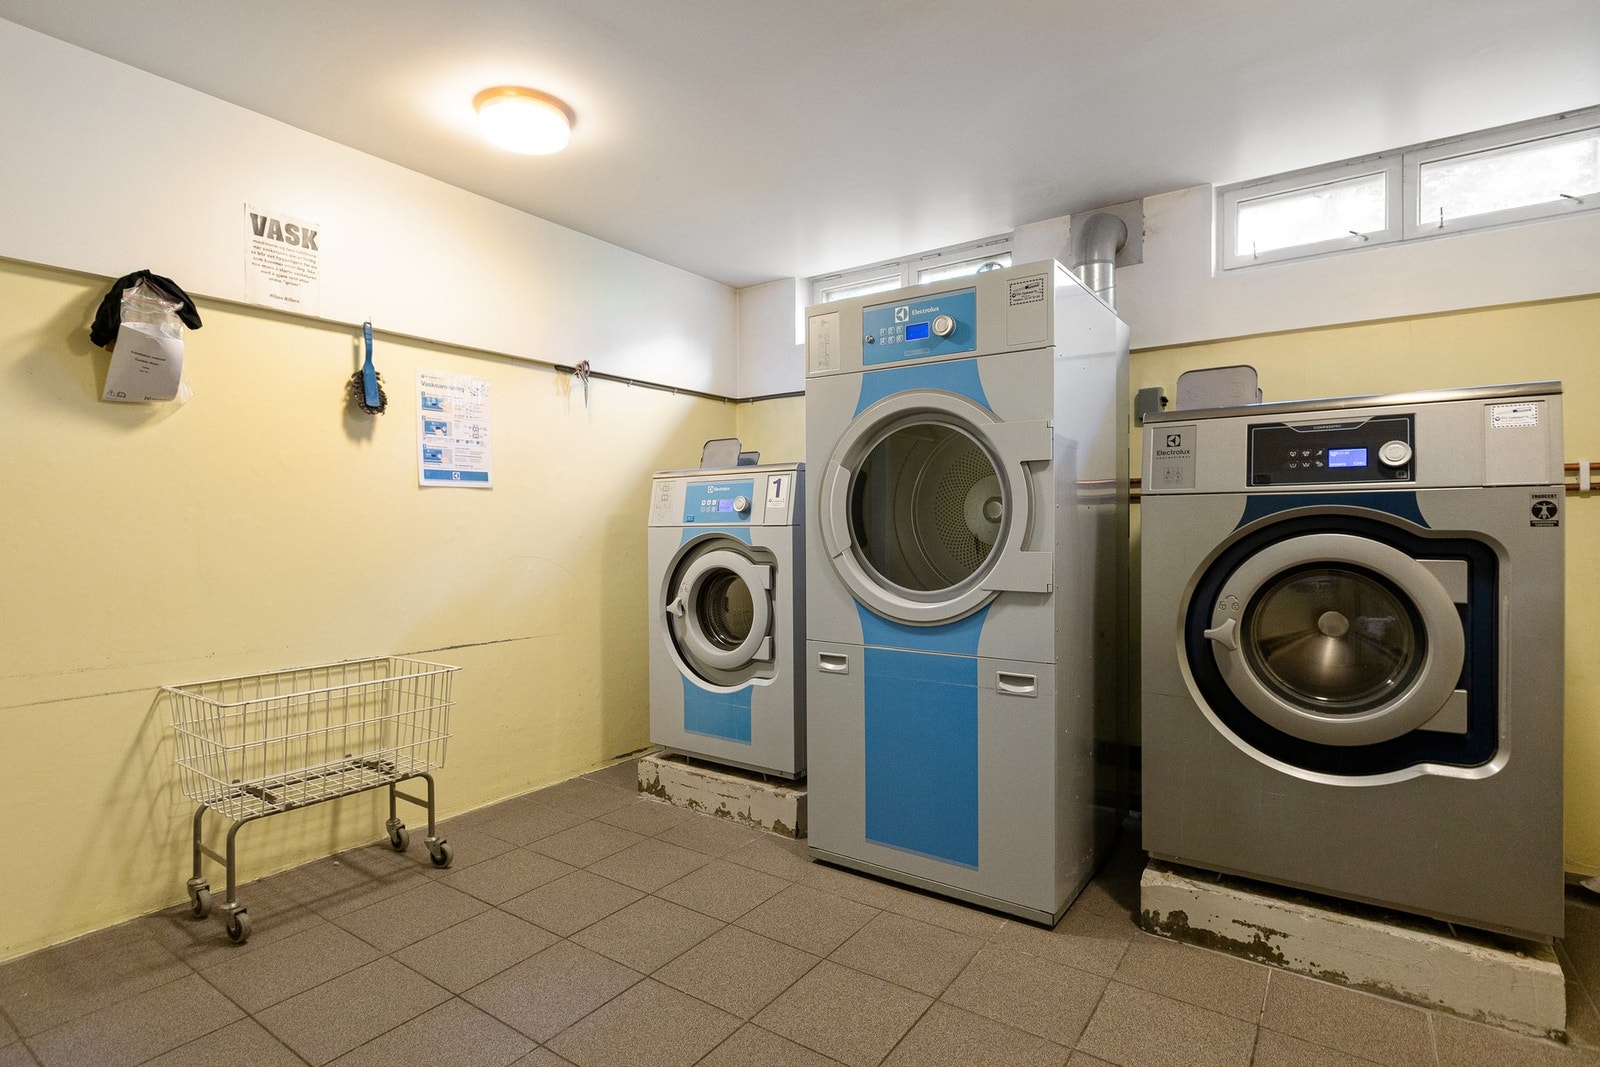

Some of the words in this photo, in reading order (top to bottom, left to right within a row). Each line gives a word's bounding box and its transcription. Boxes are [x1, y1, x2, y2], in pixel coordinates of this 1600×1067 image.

[249, 212, 319, 252] VASK
[911, 306, 940, 316] Electrolux
[773, 478, 782, 498] 1
